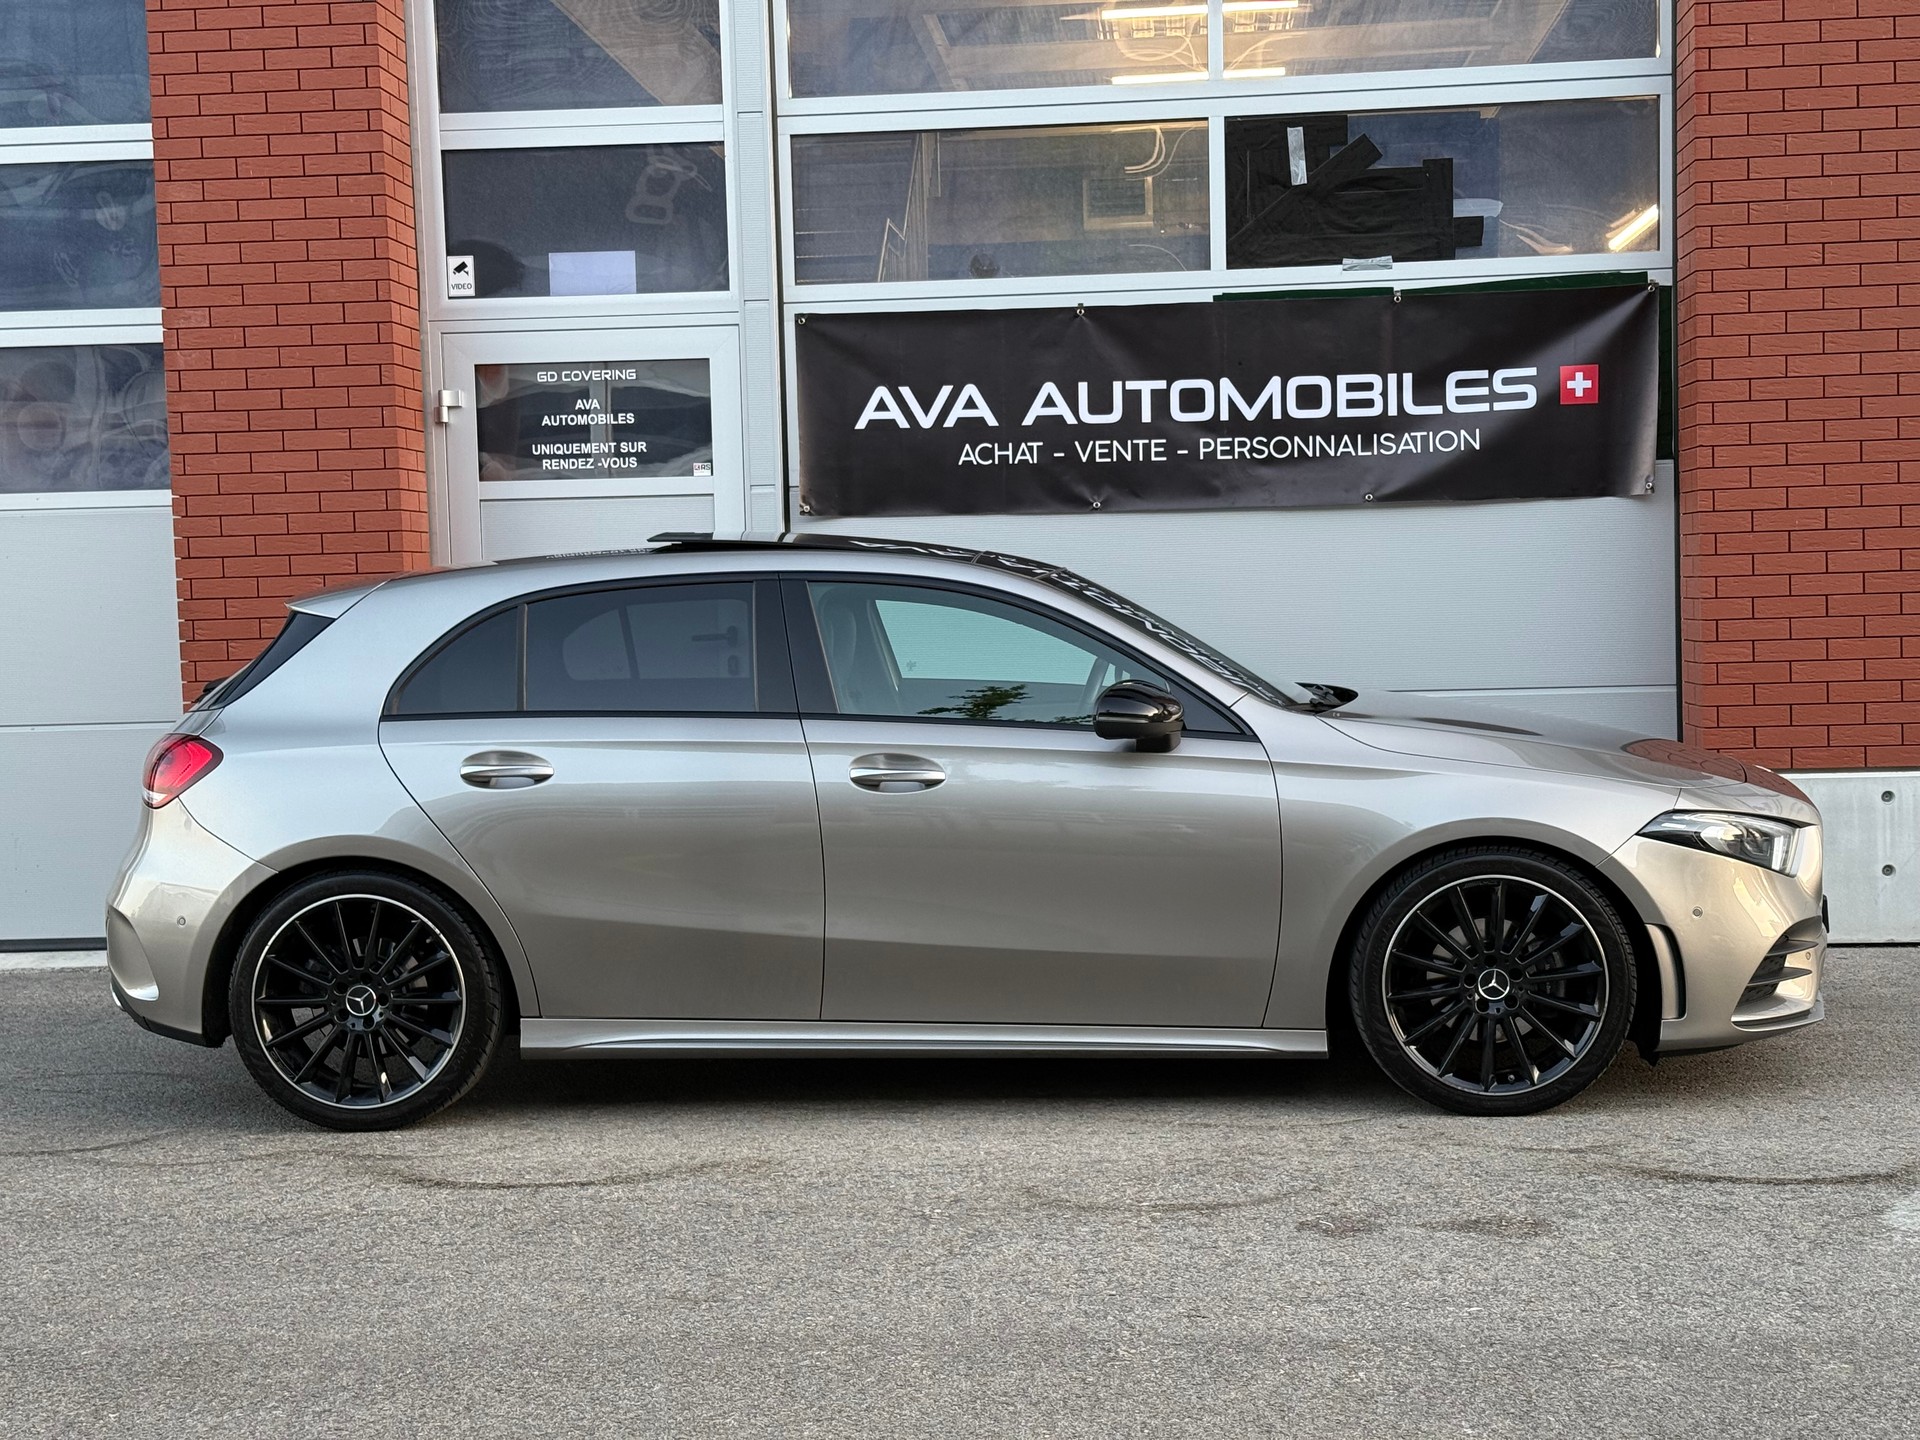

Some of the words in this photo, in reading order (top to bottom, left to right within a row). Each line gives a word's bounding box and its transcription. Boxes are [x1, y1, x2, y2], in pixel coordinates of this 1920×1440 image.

[536, 371, 558, 382] GD
[561, 368, 637, 382] COVERING
[574, 398, 601, 411] AVA
[854, 383, 999, 430] AVA
[1021, 366, 1538, 426] AUTOMOBILES
[541, 412, 635, 427] AUTOMOBILES
[532, 442, 617, 456] UNIQUEMENT
[619, 441, 647, 453] SUR
[957, 441, 1044, 466] ACHAT
[1074, 438, 1167, 463] VENTE
[1199, 428, 1480, 460] PERSONNALISATION
[542, 457, 595, 471] RENDEZ
